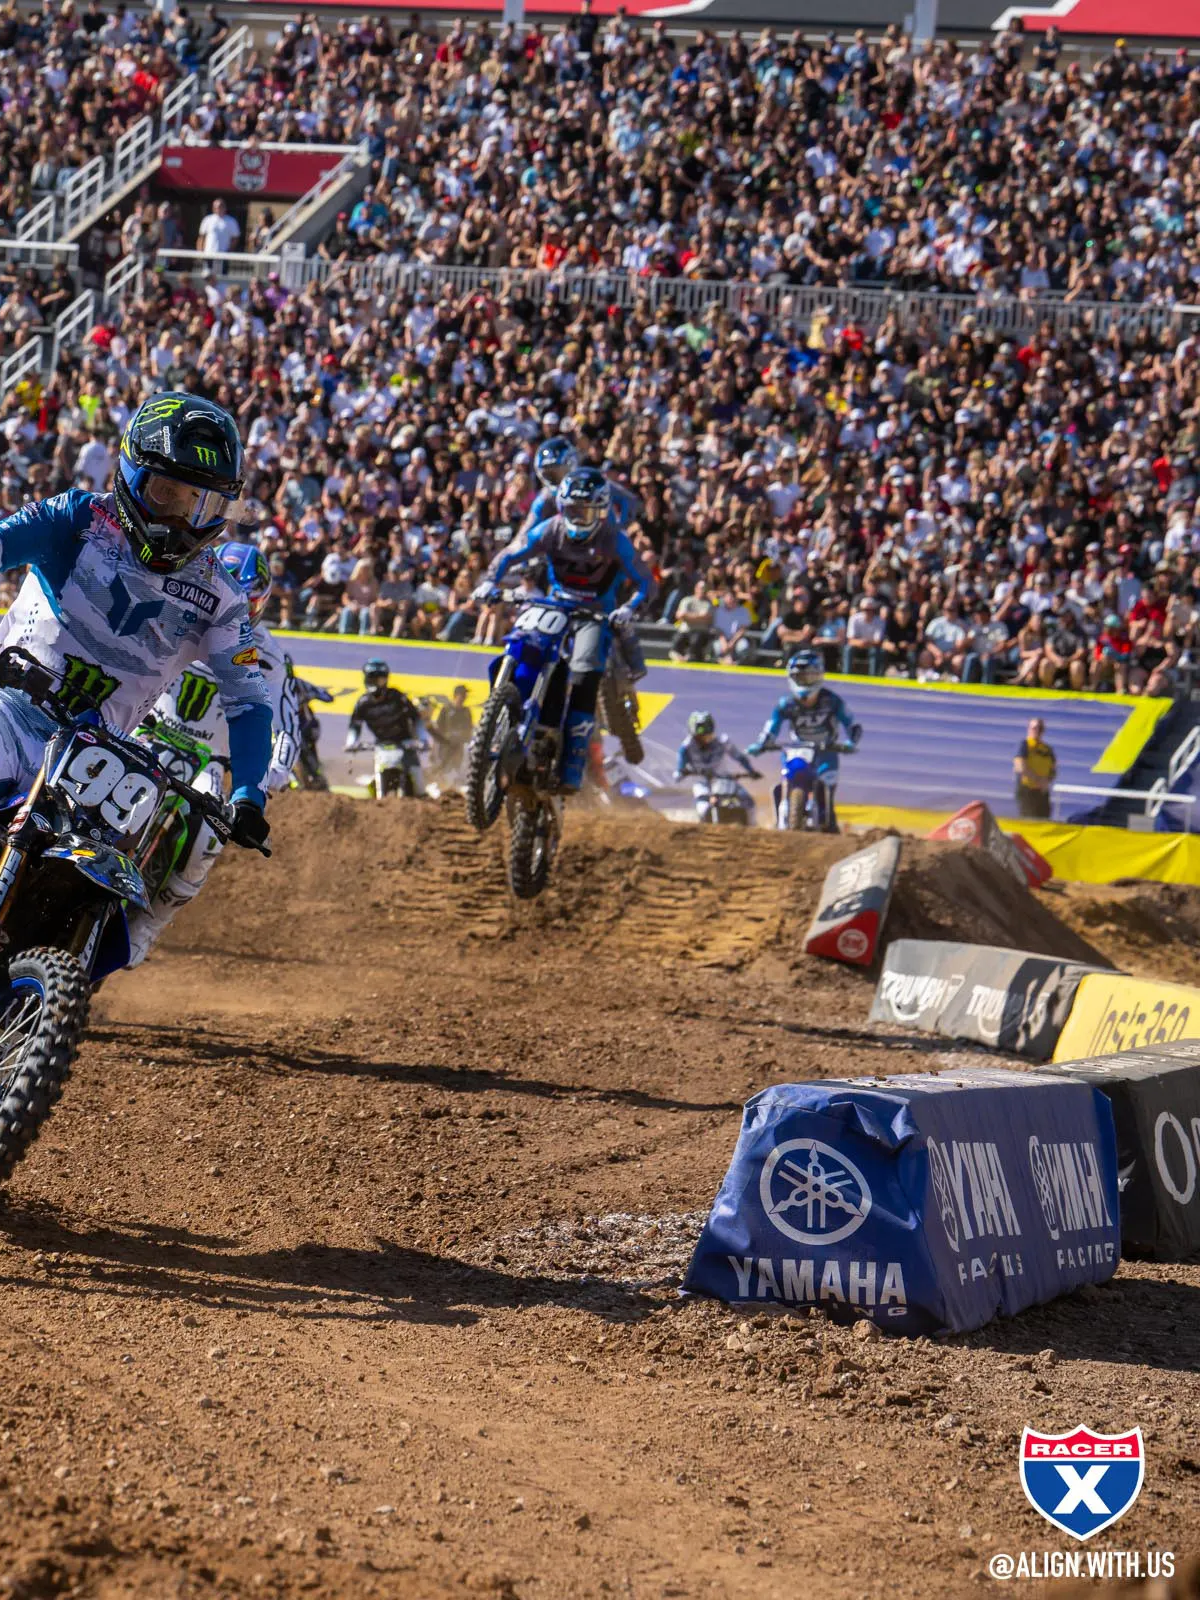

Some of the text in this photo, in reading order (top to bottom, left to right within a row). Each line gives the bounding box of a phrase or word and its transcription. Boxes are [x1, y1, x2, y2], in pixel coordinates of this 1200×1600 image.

[513, 606, 568, 635] 40
[58, 746, 159, 835] 99
[728, 1256, 907, 1305] YAMAHA
